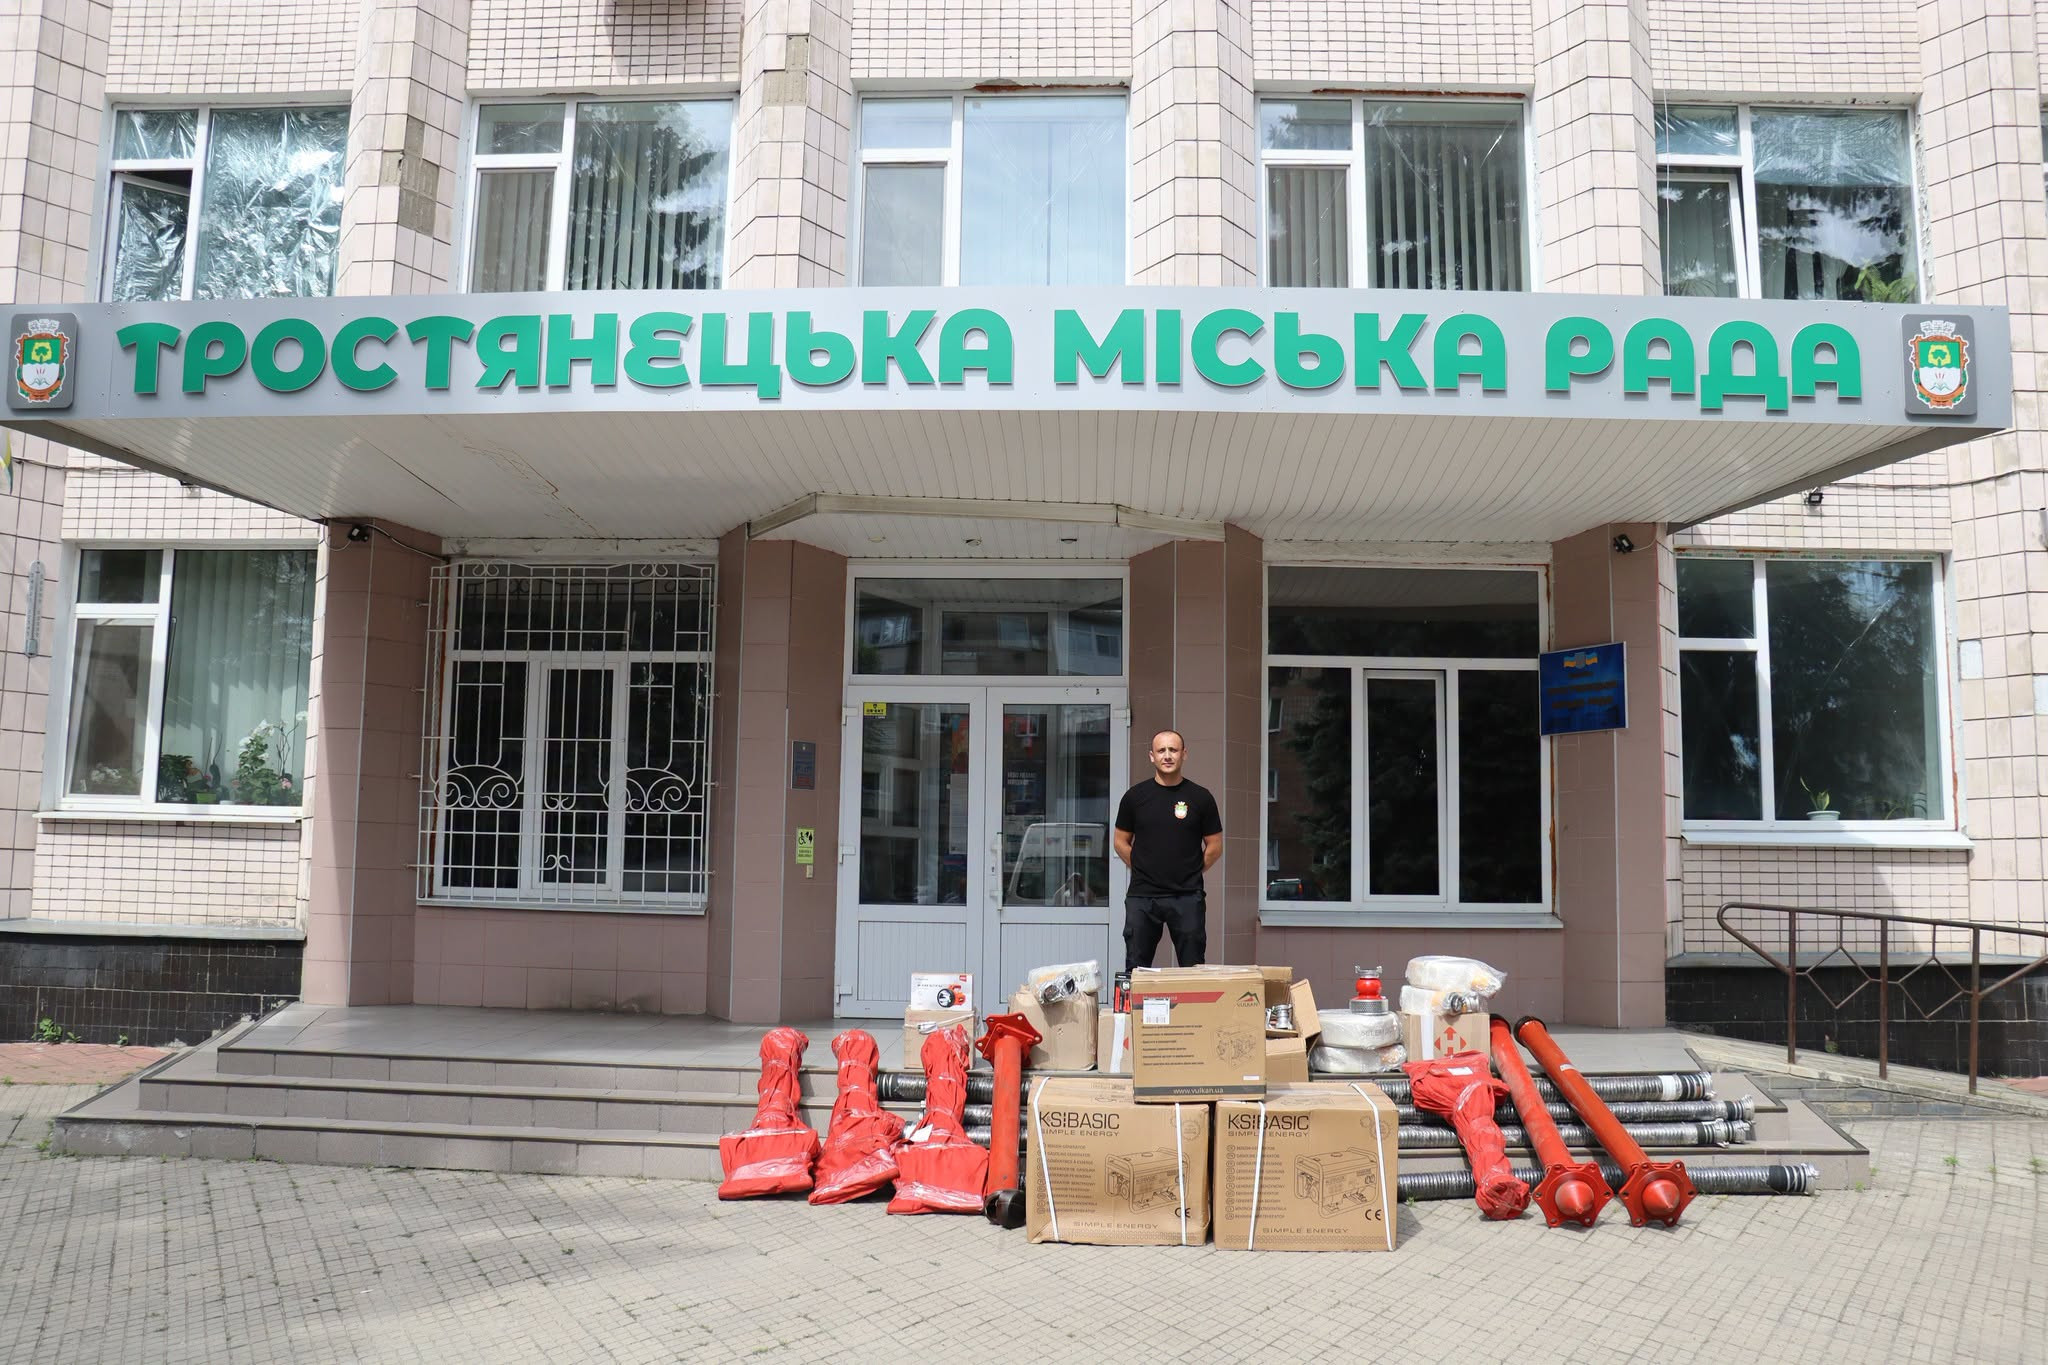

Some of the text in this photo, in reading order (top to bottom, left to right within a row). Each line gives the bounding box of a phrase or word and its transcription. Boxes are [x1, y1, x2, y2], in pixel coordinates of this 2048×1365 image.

[116, 308, 1862, 410] ТРОСТЯНЕЦЬКА МІСЬКА РАДА
[1173, 1087, 1224, 1095] www.vulkan.ua
[1080, 1129, 1120, 1137] ENERGY
